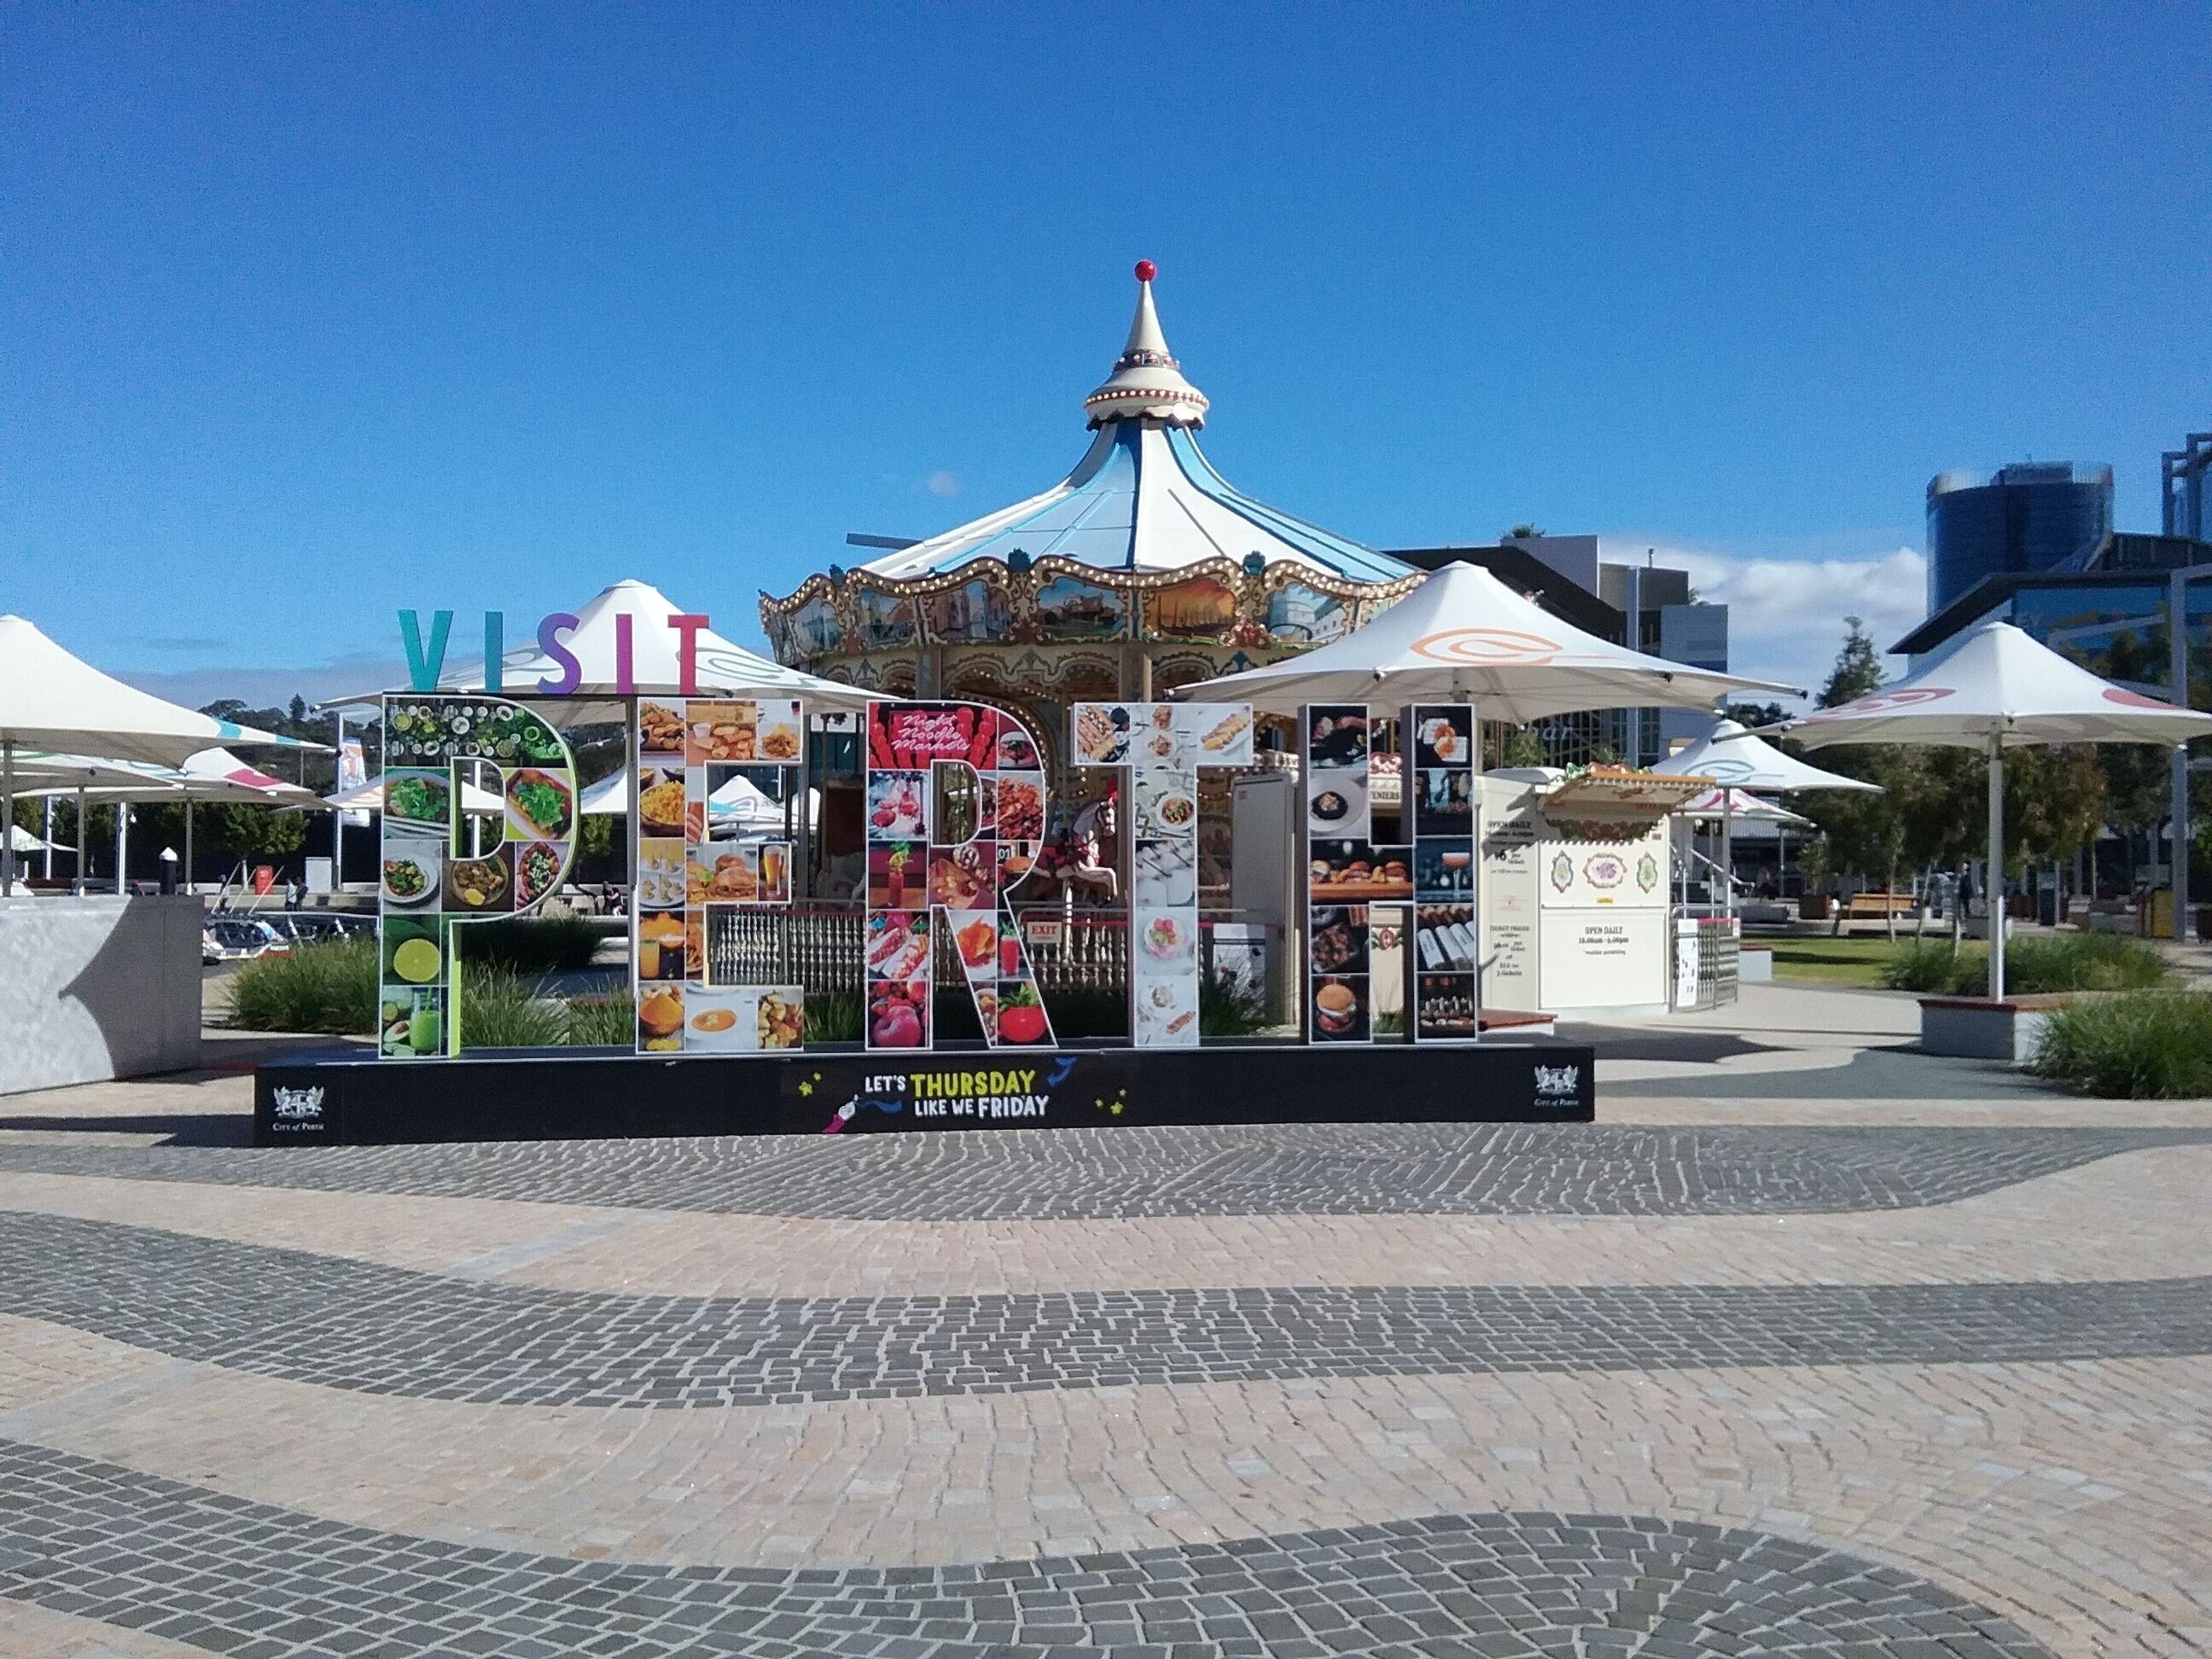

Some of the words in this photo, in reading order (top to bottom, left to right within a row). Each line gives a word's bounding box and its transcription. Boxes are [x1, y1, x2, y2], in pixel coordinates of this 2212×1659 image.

[397, 609, 709, 696] VISIT
[902, 713, 958, 731] Night
[899, 726, 962, 741] Noodle
[891, 737, 970, 752] Markets
[1370, 791, 1400, 800] ENIERS
[998, 848, 1010, 860] 01
[377, 693, 1479, 1062] PERTH
[1032, 925, 1057, 934] EXIT
[1585, 926, 1603, 934] OPEN
[1604, 926, 1623, 934] DAILY
[864, 1074, 906, 1093] LET'S
[910, 1069, 1036, 1097] THURSDAY
[915, 1099, 947, 1117] LIKE
[952, 1098, 975, 1115] WE
[978, 1094, 1050, 1119] FRIDAY
[291, 1122, 300, 1132] of
